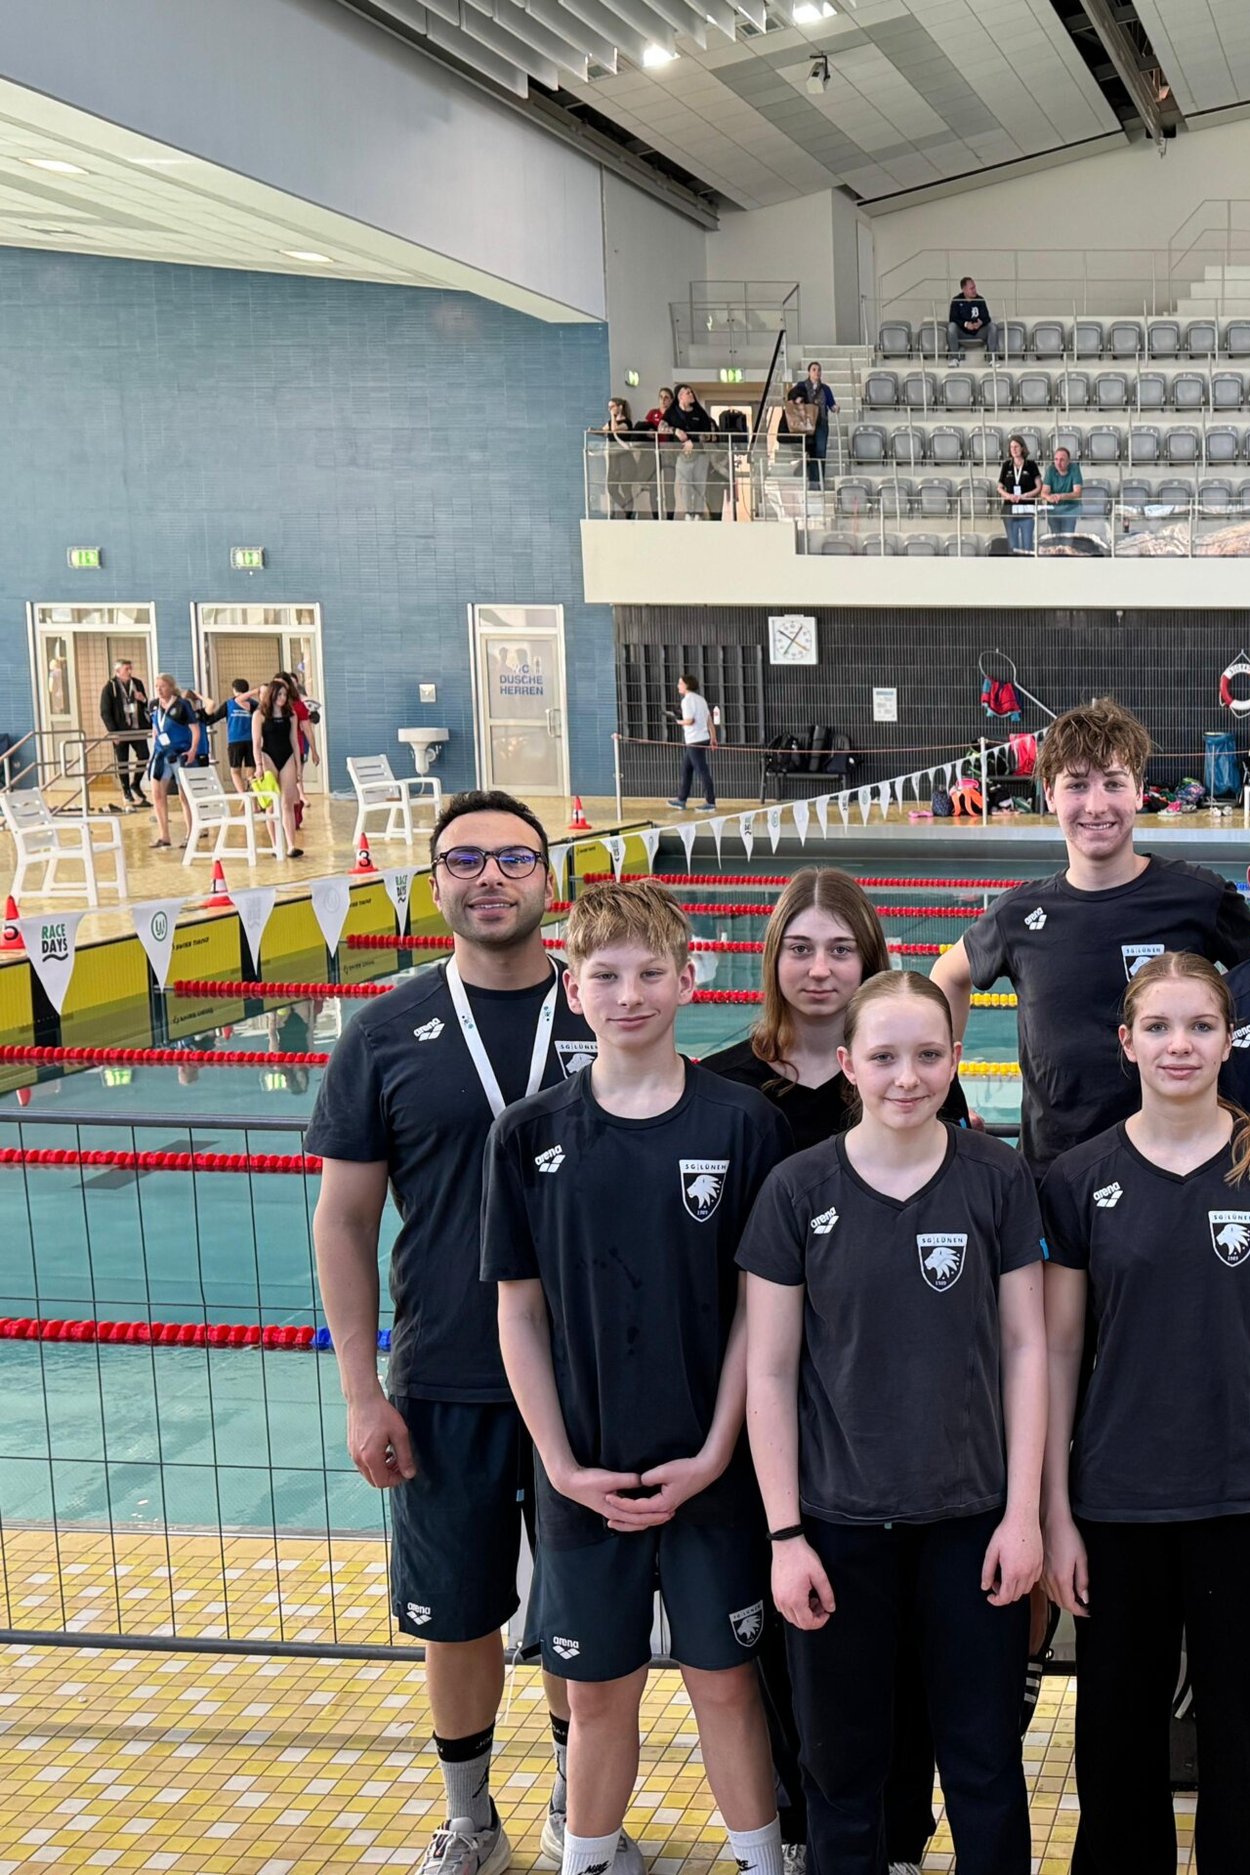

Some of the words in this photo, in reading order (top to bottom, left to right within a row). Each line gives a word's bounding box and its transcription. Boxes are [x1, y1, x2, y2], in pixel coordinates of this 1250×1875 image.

[499, 674, 543, 685] DUSCHE
[499, 686, 544, 696] HERREN
[359, 850, 371, 867] 3
[1024, 907, 1044, 925] arena
[42, 924, 66, 940] RACE
[42, 938, 68, 954] DAYS
[413, 1017, 441, 1037] arena
[534, 1144, 563, 1166] arena
[685, 1163, 696, 1171] SG
[1093, 1181, 1121, 1201] arena
[810, 1206, 837, 1229] arena
[1213, 1213, 1224, 1221] SG
[922, 1236, 932, 1244] SG
[407, 1602, 431, 1615] arena
[553, 1636, 580, 1649] arena
